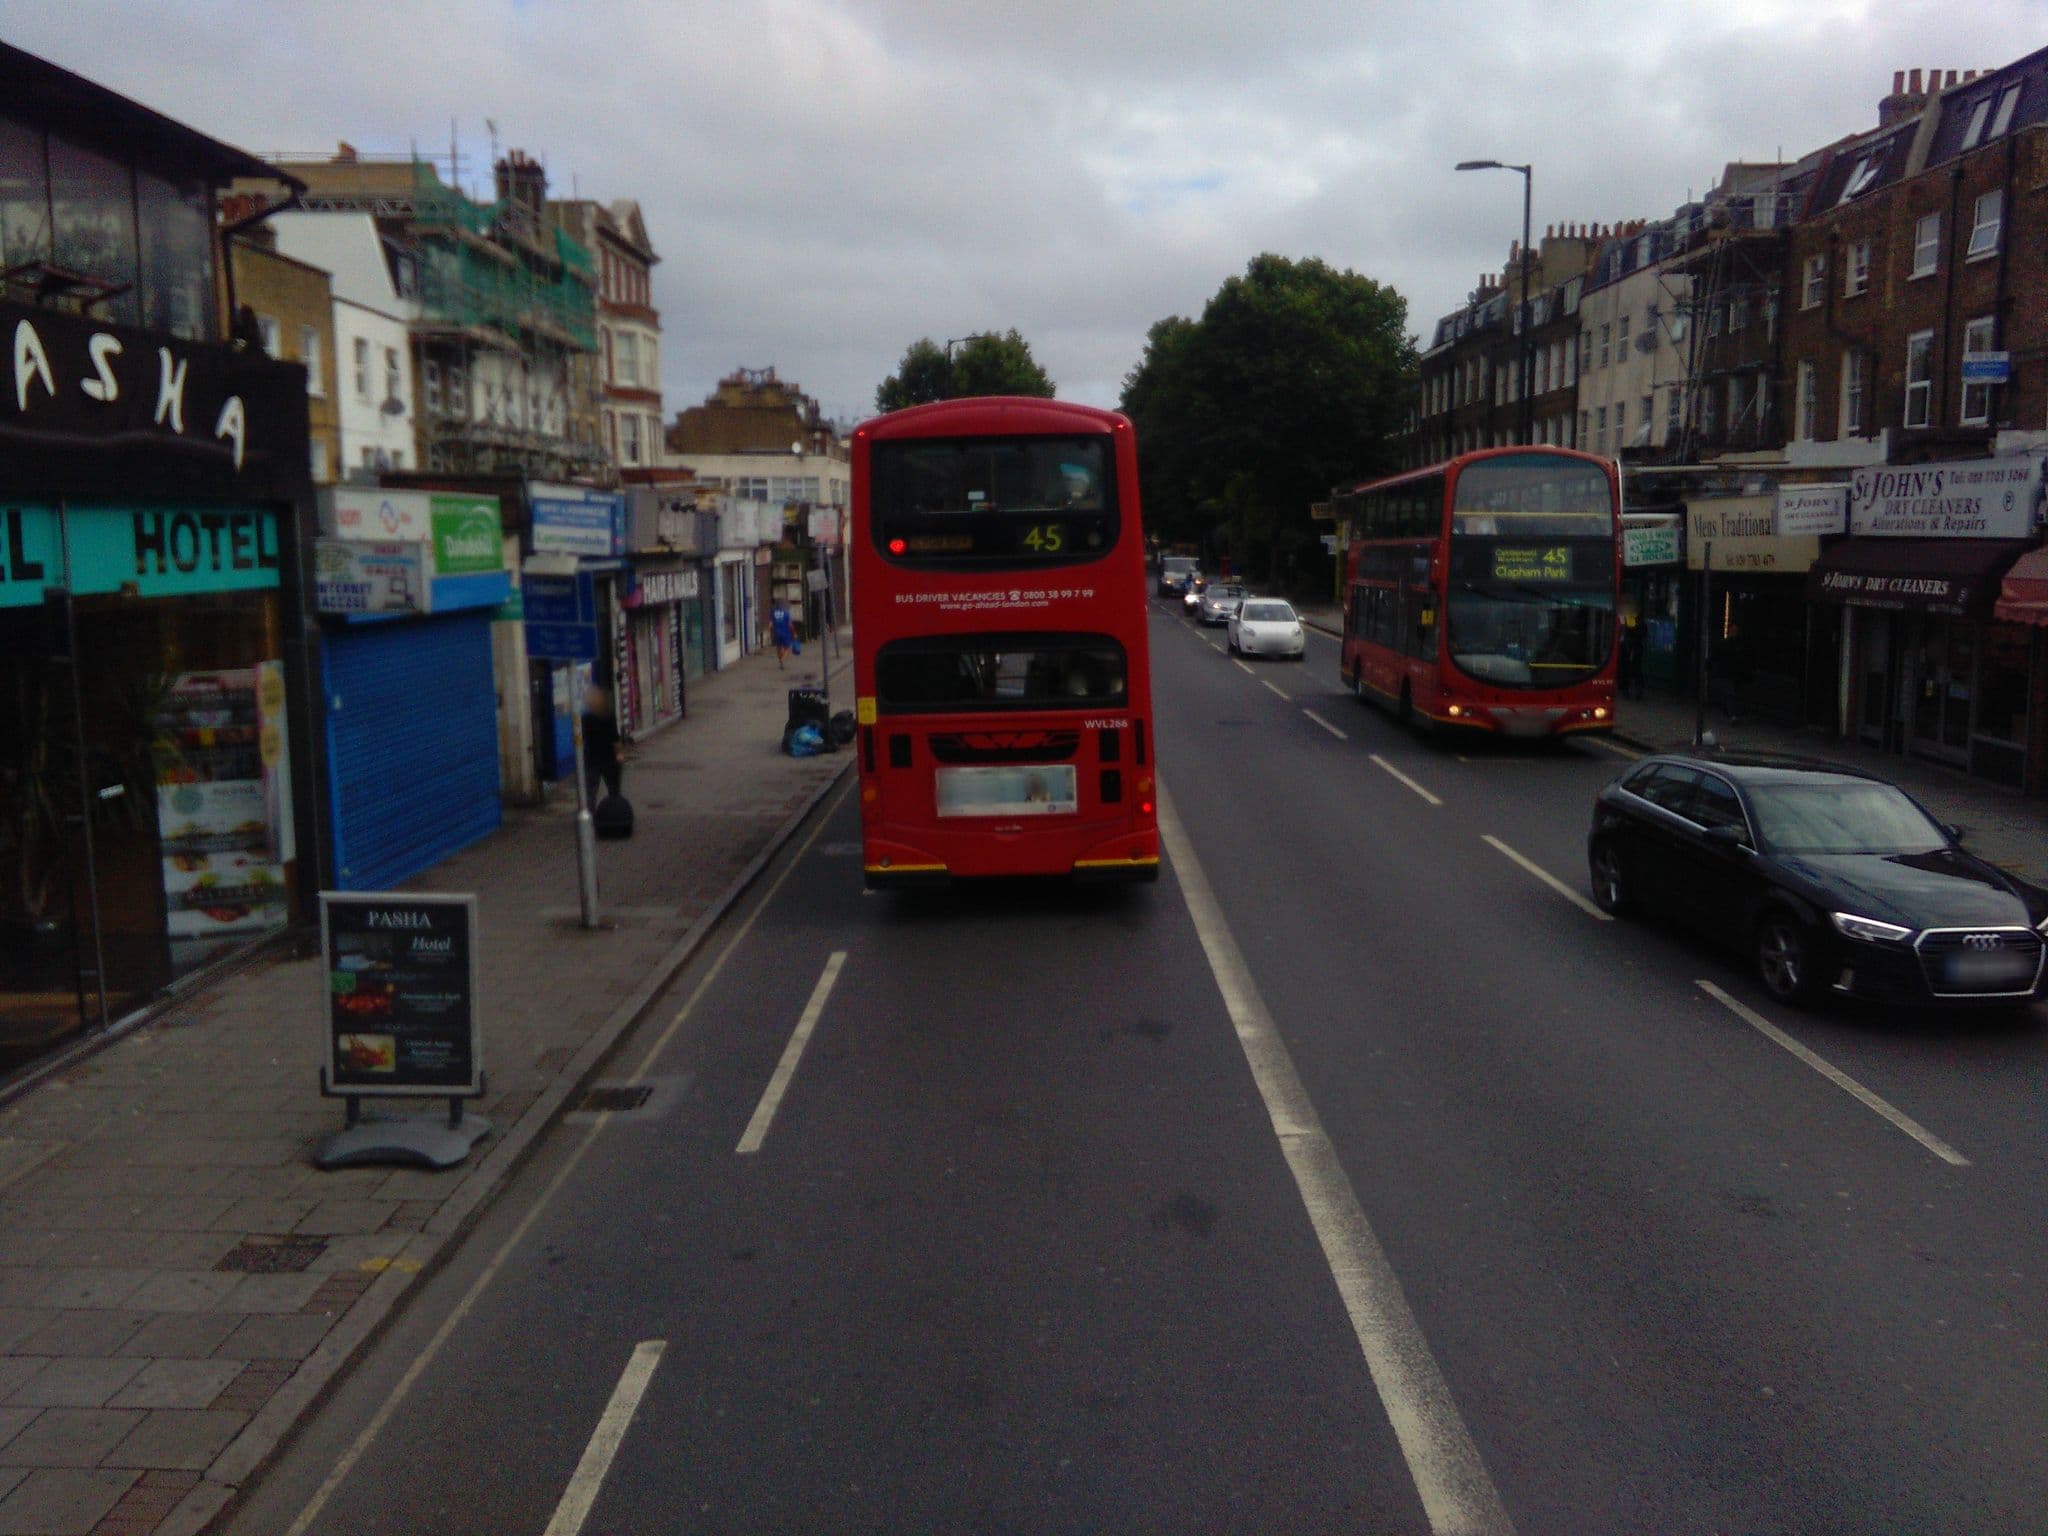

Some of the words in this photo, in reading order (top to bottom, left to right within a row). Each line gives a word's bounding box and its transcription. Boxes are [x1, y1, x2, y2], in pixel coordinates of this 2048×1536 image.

[1863, 470, 1944, 512] JOHN'S
[1884, 499, 1909, 516] DRY
[1911, 497, 1982, 515] CLEANERS
[1720, 511, 1771, 537] Traditiona
[1930, 519, 1939, 530] &
[1943, 515, 1987, 533] Repairs
[0, 508, 44, 583] L
[133, 510, 279, 576] HOTEL
[1024, 524, 1062, 552] 45
[1543, 547, 1566, 564] 45
[1495, 566, 1541, 578] Clapham
[1544, 566, 1567, 578] Park
[1865, 576, 1889, 591] DRY
[1889, 578, 1949, 595] CLEANERS
[895, 593, 914, 603] BUS
[915, 592, 949, 602] DRIVER
[952, 591, 1006, 602] VACANCIES
[1023, 590, 1046, 600] 0800
[940, 600, 1049, 610] www.go-ahead-london.com
[368, 910, 433, 929] PASHA
[411, 935, 452, 952] Hotel
